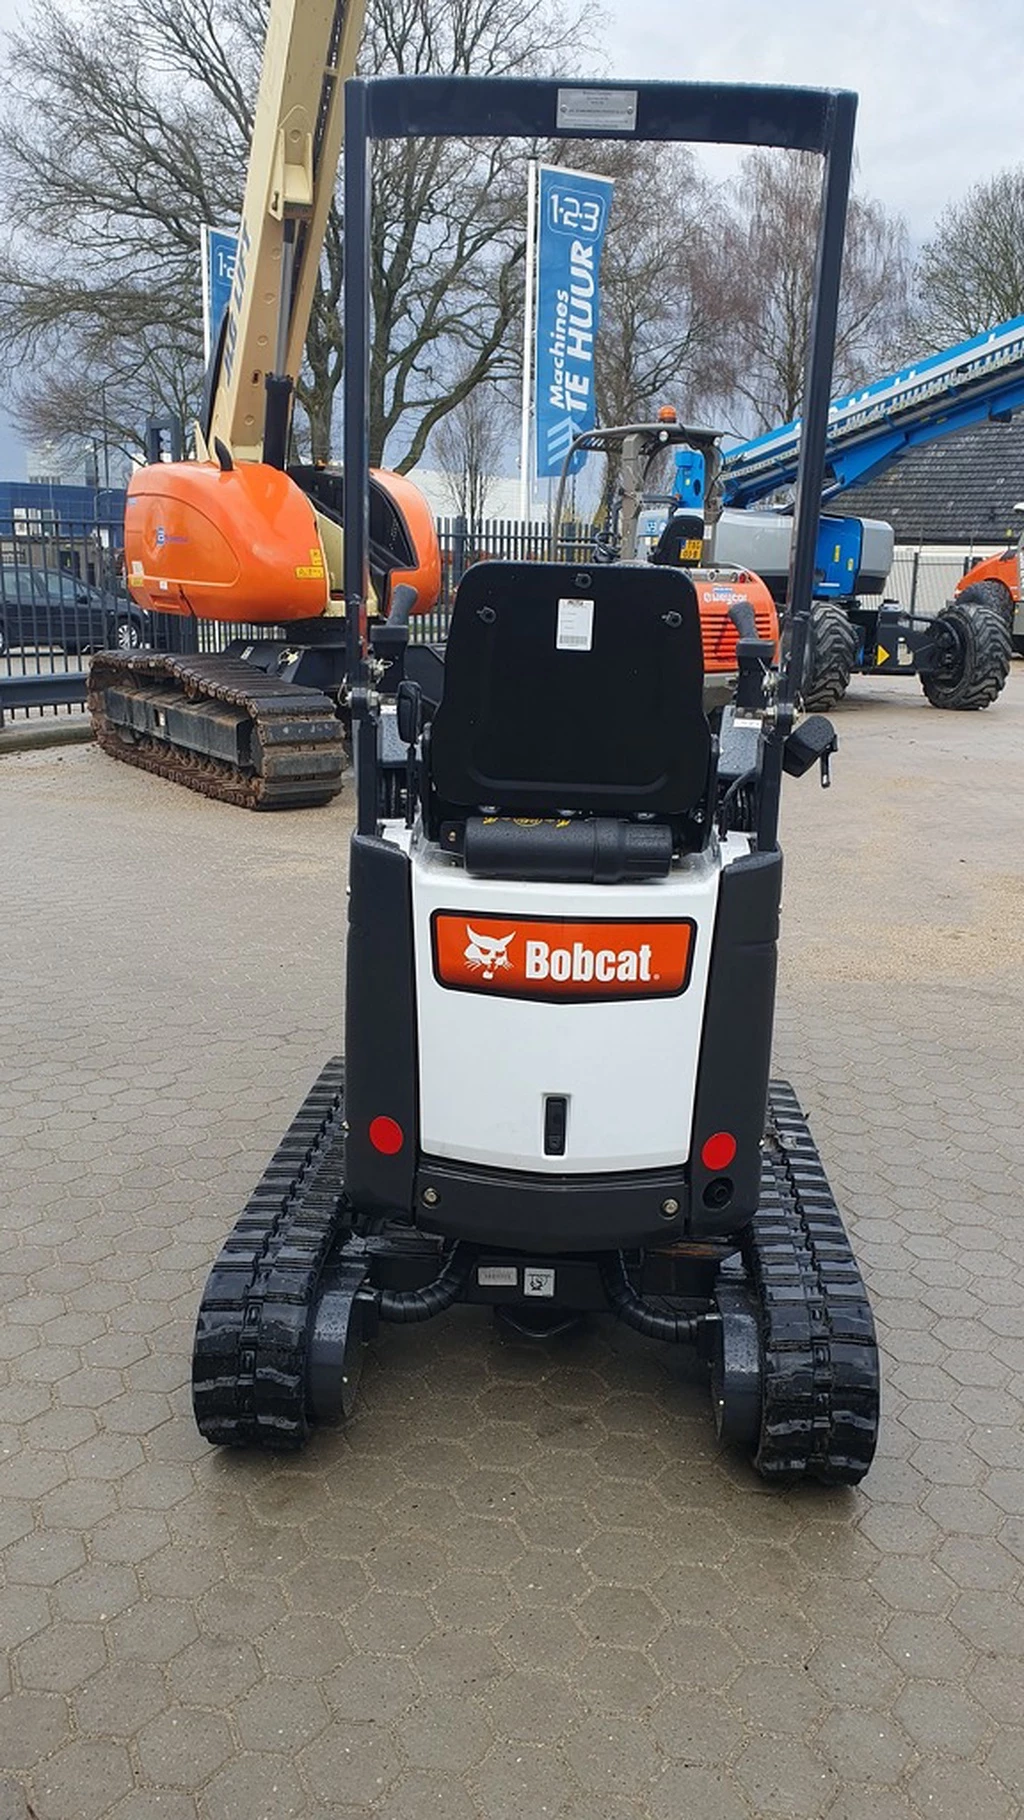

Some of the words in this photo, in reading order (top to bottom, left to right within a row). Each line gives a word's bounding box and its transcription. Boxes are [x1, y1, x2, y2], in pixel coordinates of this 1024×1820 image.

[234, 219, 250, 312] LIFT
[567, 240, 594, 361] HUUR
[549, 289, 569, 409] Machines
[565, 371, 590, 411] TE
[525, 940, 652, 982] Bobcat
